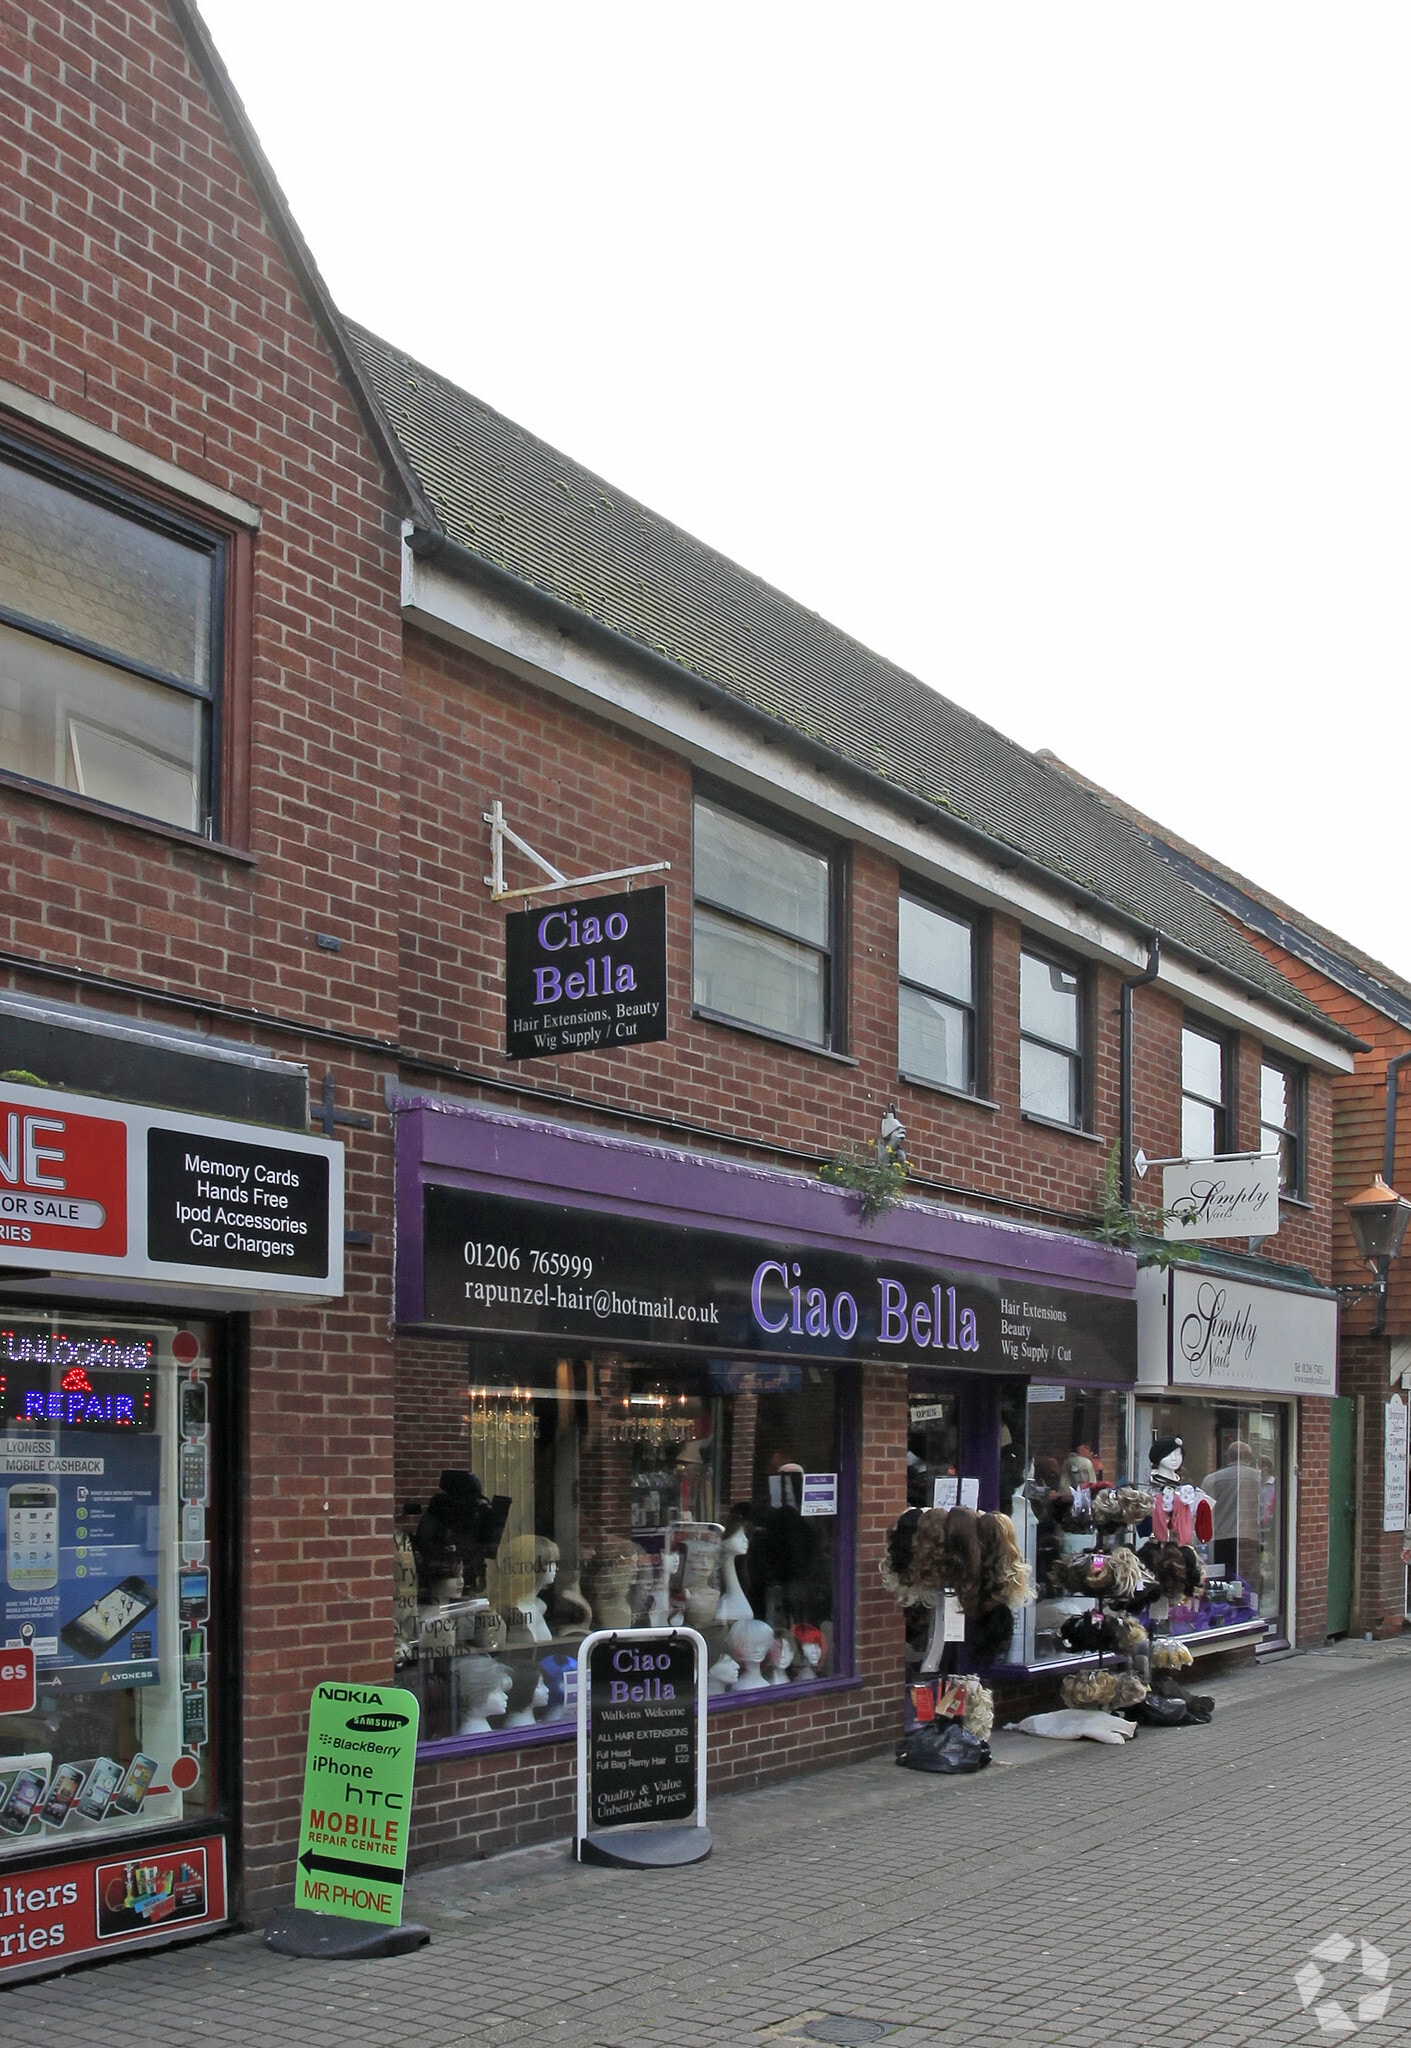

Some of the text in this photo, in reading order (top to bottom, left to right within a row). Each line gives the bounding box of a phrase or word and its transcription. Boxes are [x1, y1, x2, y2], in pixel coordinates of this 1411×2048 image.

[538, 908, 628, 951] Ciao
[533, 955, 637, 1005] Bella
[513, 1002, 660, 1033] Hair Extensions, Beauty
[534, 1033, 557, 1049] Wig
[561, 1026, 602, 1046] Supply
[615, 1022, 638, 1037] Cut
[185, 1153, 299, 1187] Memory Cards
[198, 1180, 289, 1209] Hands Free
[1171, 1180, 1270, 1215] Simply
[34, 1200, 79, 1220] SALE
[176, 1202, 307, 1234] Ipod Accessories
[1197, 1206, 1233, 1225] Nails
[190, 1228, 295, 1257] Car Chargers
[464, 1241, 593, 1279] 01206 765999
[465, 1280, 719, 1324] rapunzel-hair@hotmail.co.uk
[751, 1260, 980, 1352] Ciao Bella
[1000, 1298, 1067, 1321] Hair Extensions
[1001, 1319, 1031, 1340] Beauty
[1181, 1282, 1258, 1361] Simply
[8, 1338, 148, 1369] UNLOCKING
[1001, 1340, 1019, 1360] Wig
[1021, 1342, 1049, 1362] Supply
[1057, 1346, 1072, 1361] Cut
[61, 1367, 92, 1392] &
[26, 1391, 134, 1424] REPAIR
[916, 1408, 937, 1419] OPEN
[6, 1441, 52, 1453] LYONESS
[6, 1459, 101, 1472] MOBILE CASHBACK
[464, 1610, 502, 1632] Spray
[1, 1664, 27, 1681] es
[612, 1648, 671, 1673] Ciao
[112, 1671, 153, 1681] LYONESS
[318, 1688, 383, 1706] NOKIA
[609, 1677, 676, 1704] Bella
[353, 1716, 402, 1730] SAMSUNG
[601, 1707, 686, 1720] Walk-ins Welcome
[597, 1728, 688, 1742] ALL HAIR EXTENSIONS
[333, 1737, 401, 1759] BlackBerry
[596, 1750, 609, 1759] Full
[611, 1749, 632, 1758] Head
[312, 1755, 374, 1779] iPhone
[596, 1761, 609, 1770] Full
[611, 1760, 626, 1770] Bag
[651, 1757, 667, 1766] Hair
[597, 1791, 687, 1818] Unbeatable Prices
[598, 1779, 682, 1805] Quality & Value
[309, 1808, 399, 1842] MOBILE
[308, 1832, 397, 1855] REPAIR CENTRE
[0, 1882, 78, 1918] lters
[304, 1880, 392, 1914] MR PHONE
